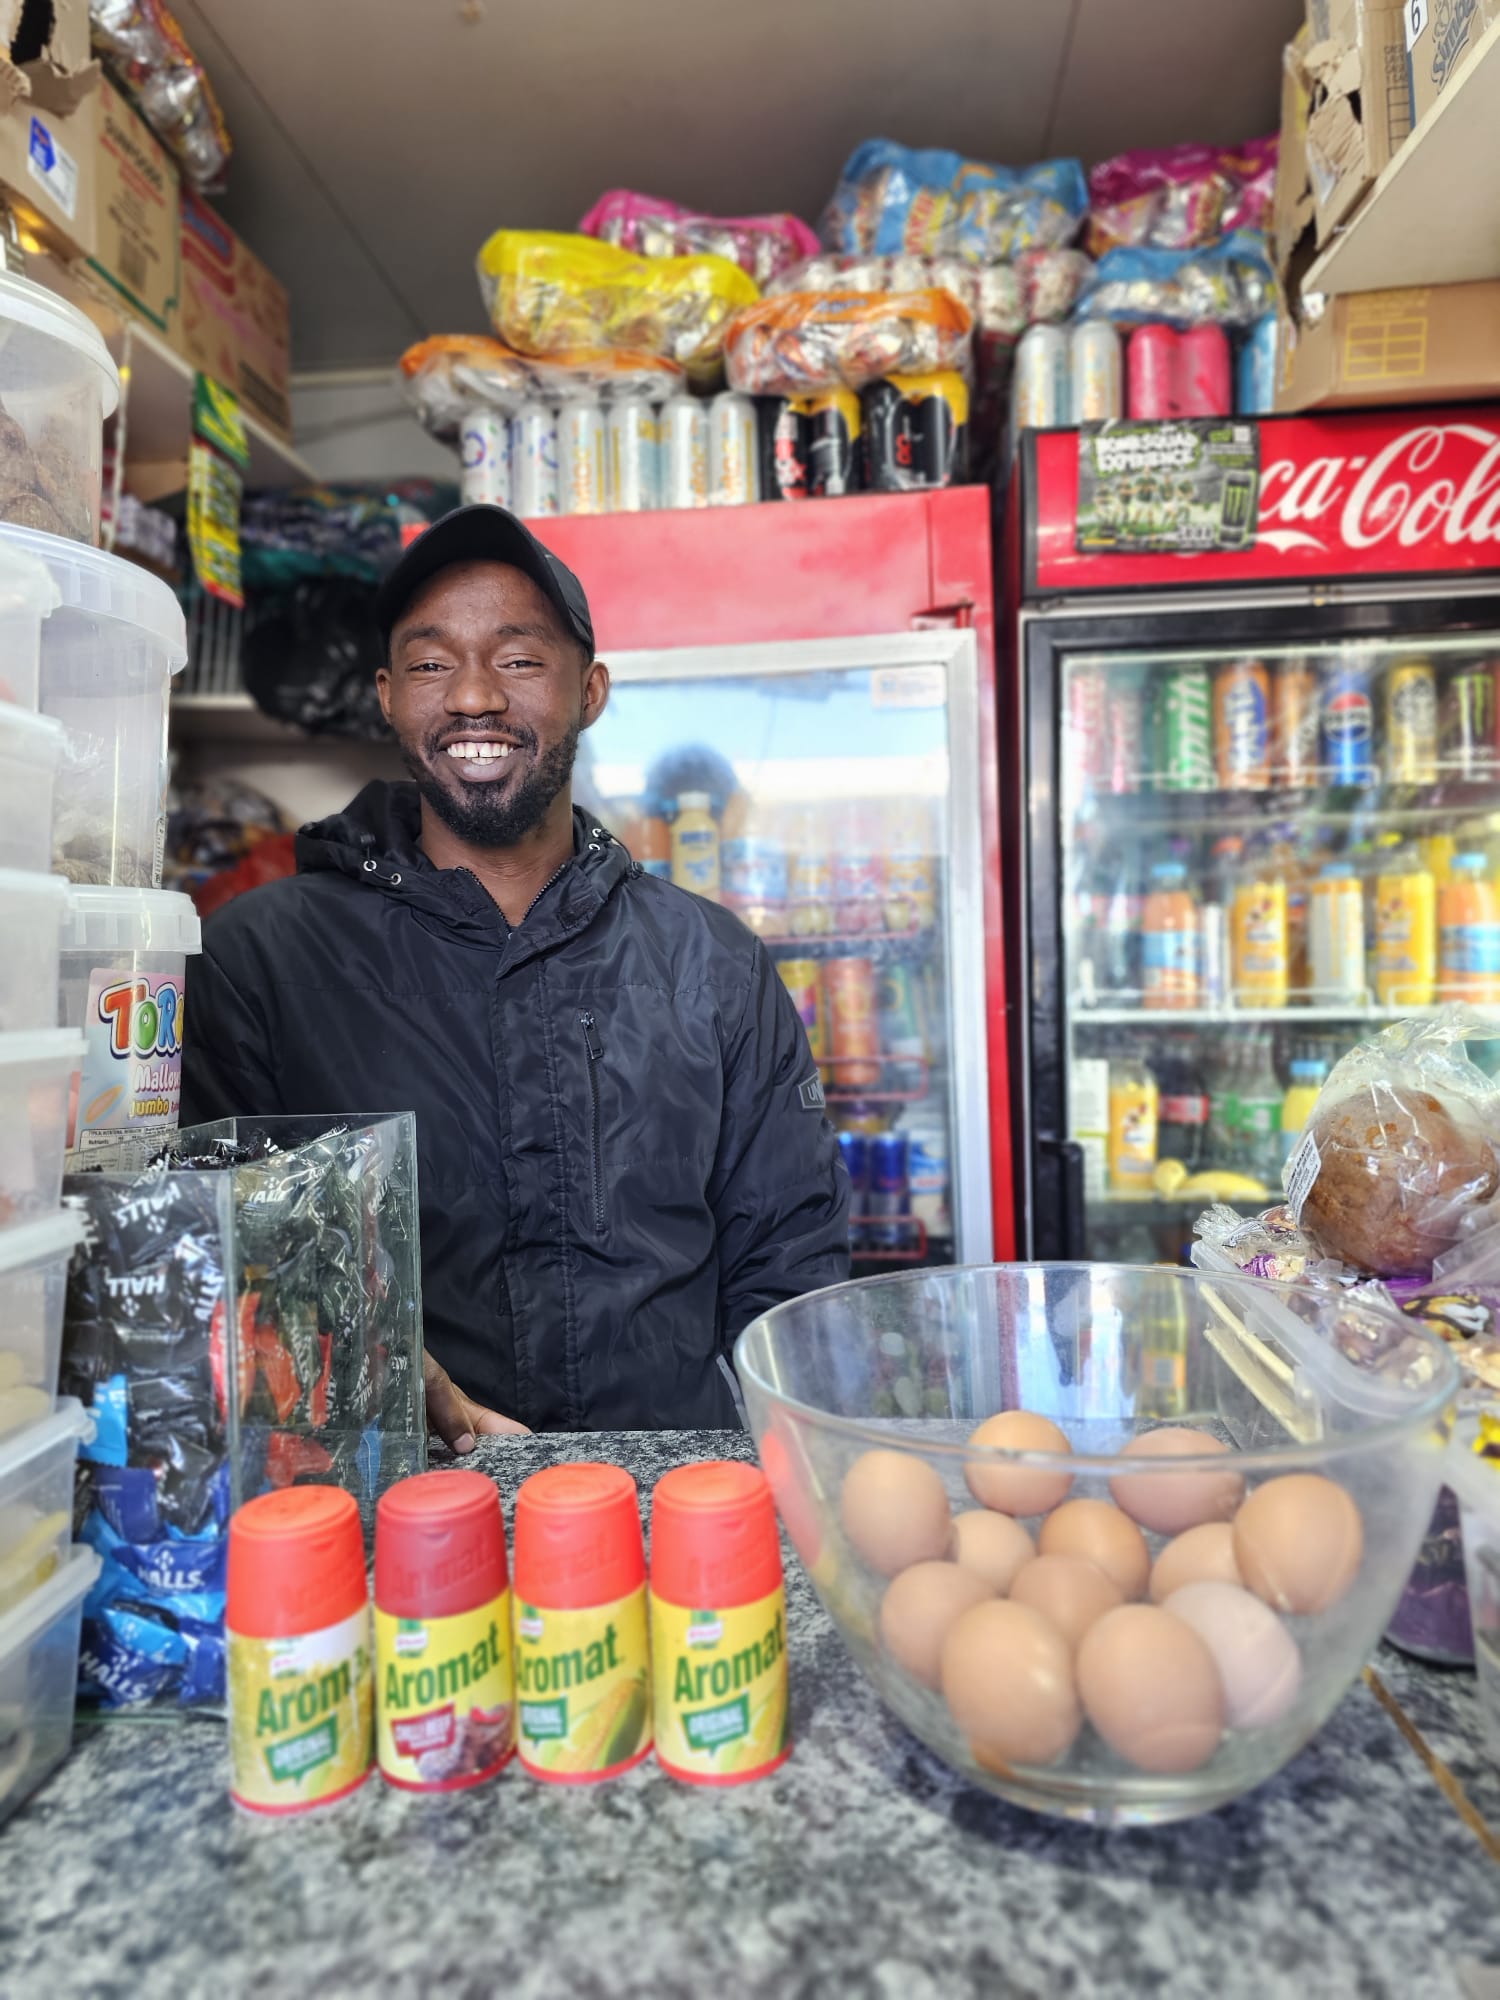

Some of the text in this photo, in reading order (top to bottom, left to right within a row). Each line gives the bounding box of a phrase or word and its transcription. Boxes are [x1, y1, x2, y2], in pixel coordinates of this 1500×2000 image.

[1256, 424, 1500, 551] ca-Col
[105, 1265, 165, 1297] HALL
[138, 1569, 205, 1590] HALLS
[78, 1650, 148, 1700] HALLS
[256, 1648, 368, 1738] Arom
[385, 1622, 501, 1709] Aromat
